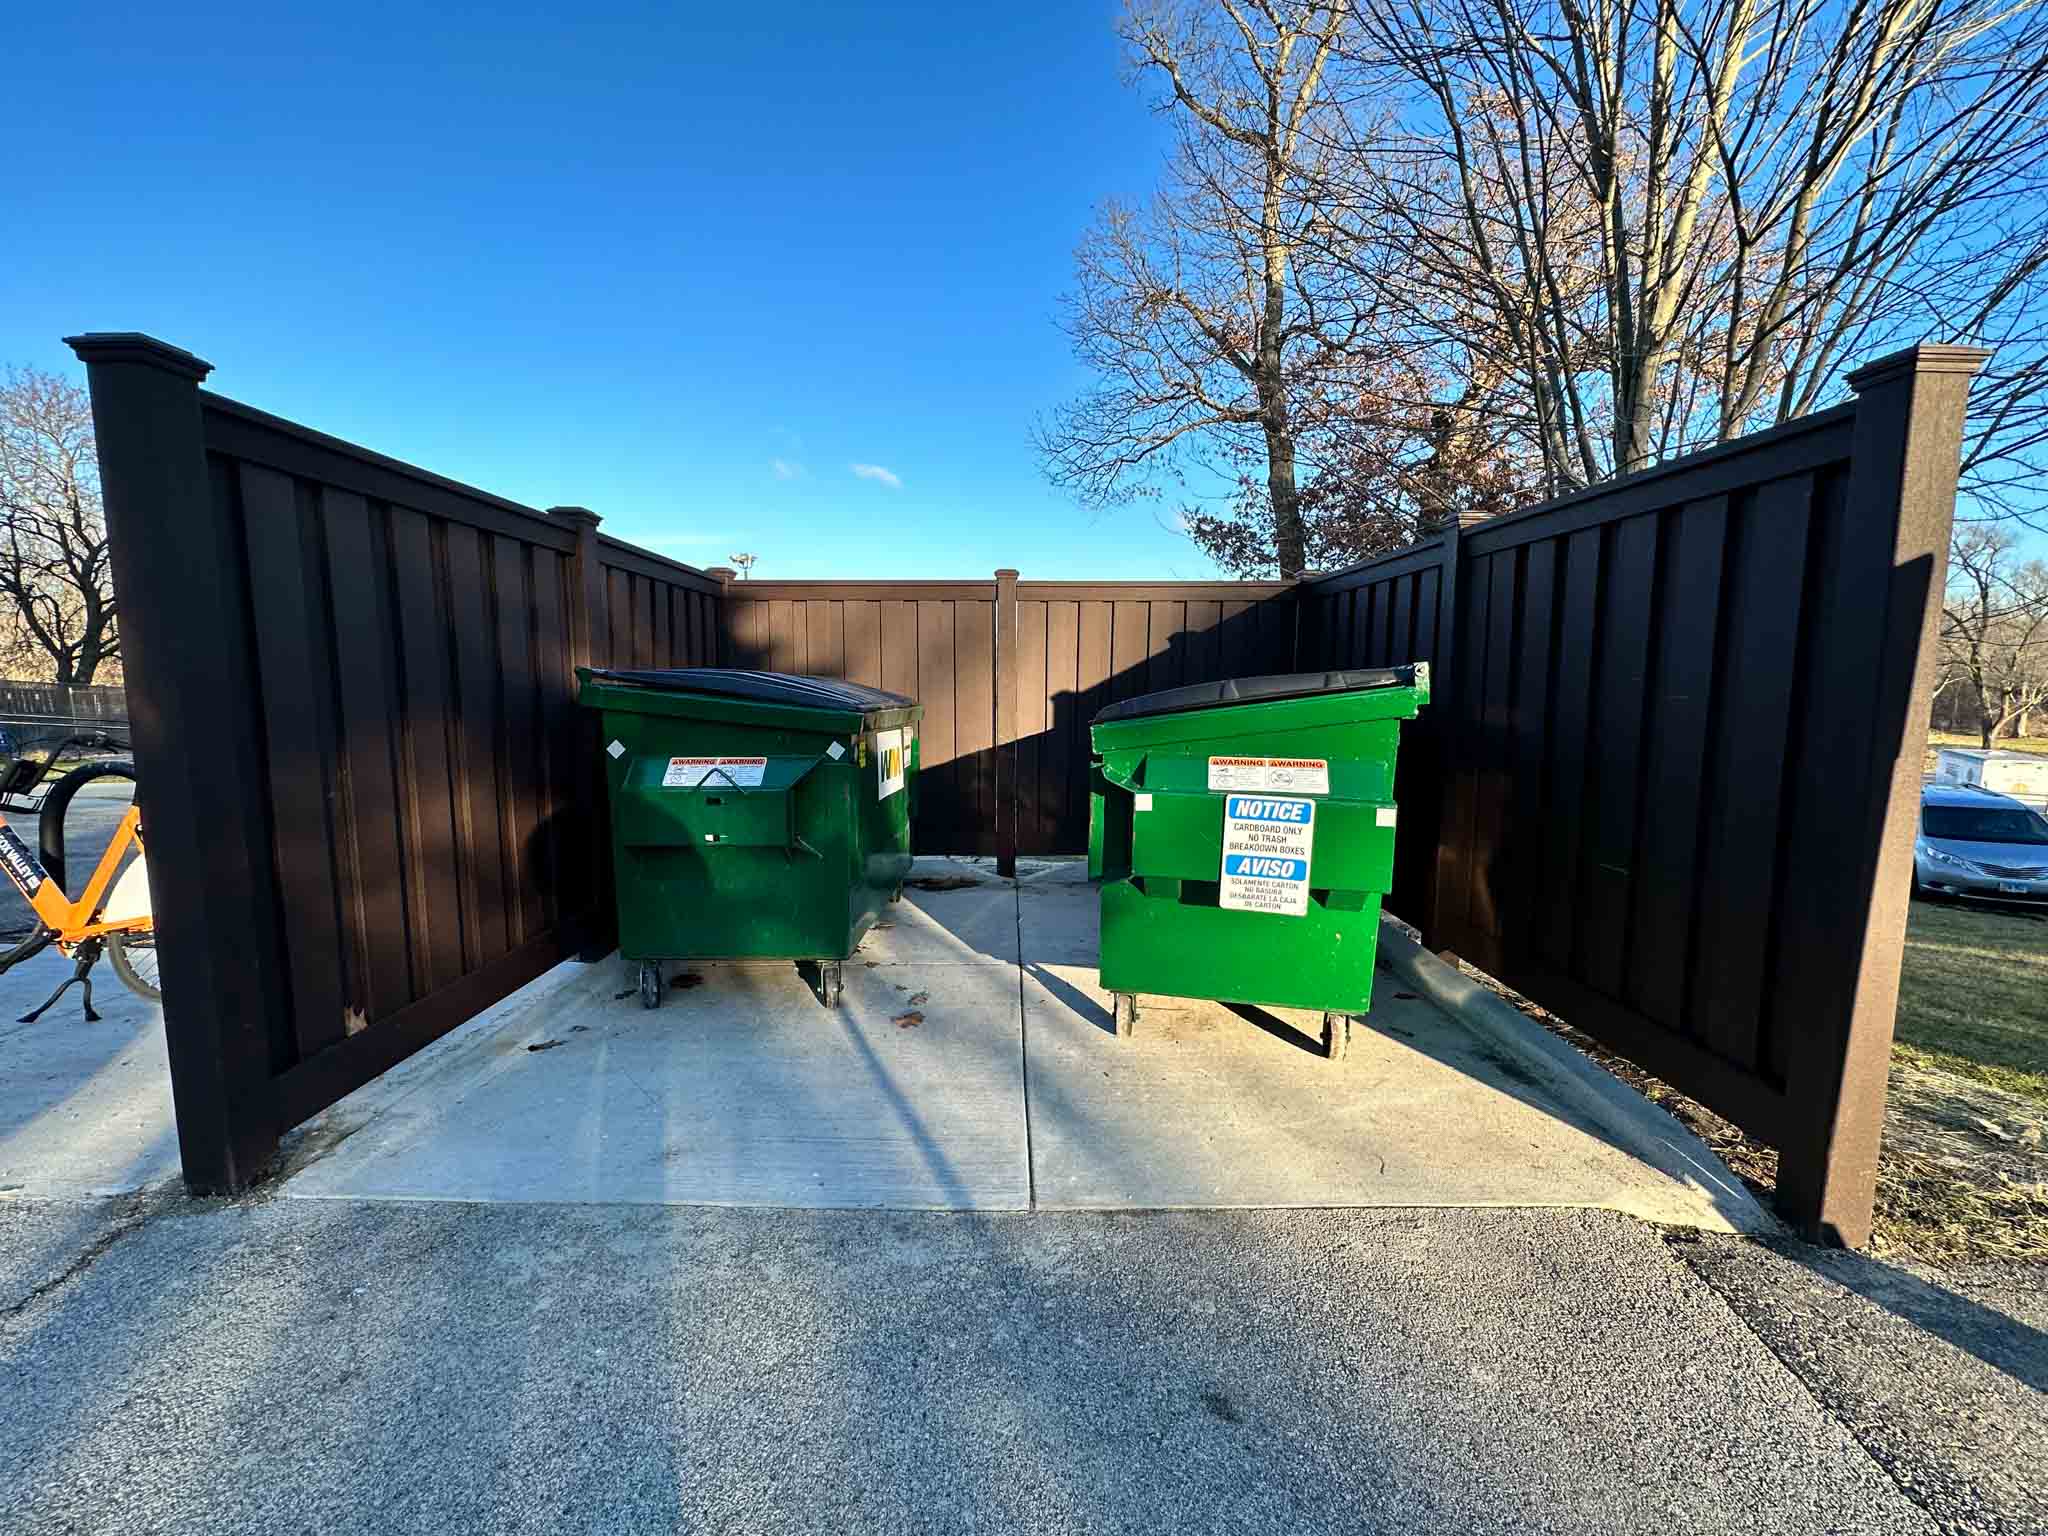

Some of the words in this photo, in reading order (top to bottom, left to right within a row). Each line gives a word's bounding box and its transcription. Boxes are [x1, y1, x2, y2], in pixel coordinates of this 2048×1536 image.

[1218, 759, 1264, 767] WARNING
[1277, 760, 1323, 768] WARNING
[1235, 799, 1305, 821] NOTICE
[1233, 823, 1281, 834] CARDBOARD
[1283, 826, 1303, 836] ONLY
[1248, 834, 1259, 842] NO
[1262, 835, 1287, 844] TRASH
[1229, 842, 1277, 853] BREAKDOWN
[1279, 846, 1305, 855] BOXES
[6, 848, 34, 878] VALLEY
[1236, 857, 1296, 878] AVISO
[1231, 878, 1269, 887] SOLAMENTE
[1255, 887, 1282, 896] BASURA
[1268, 895, 1278, 903] LA
[1279, 896, 1297, 904] CAJA
